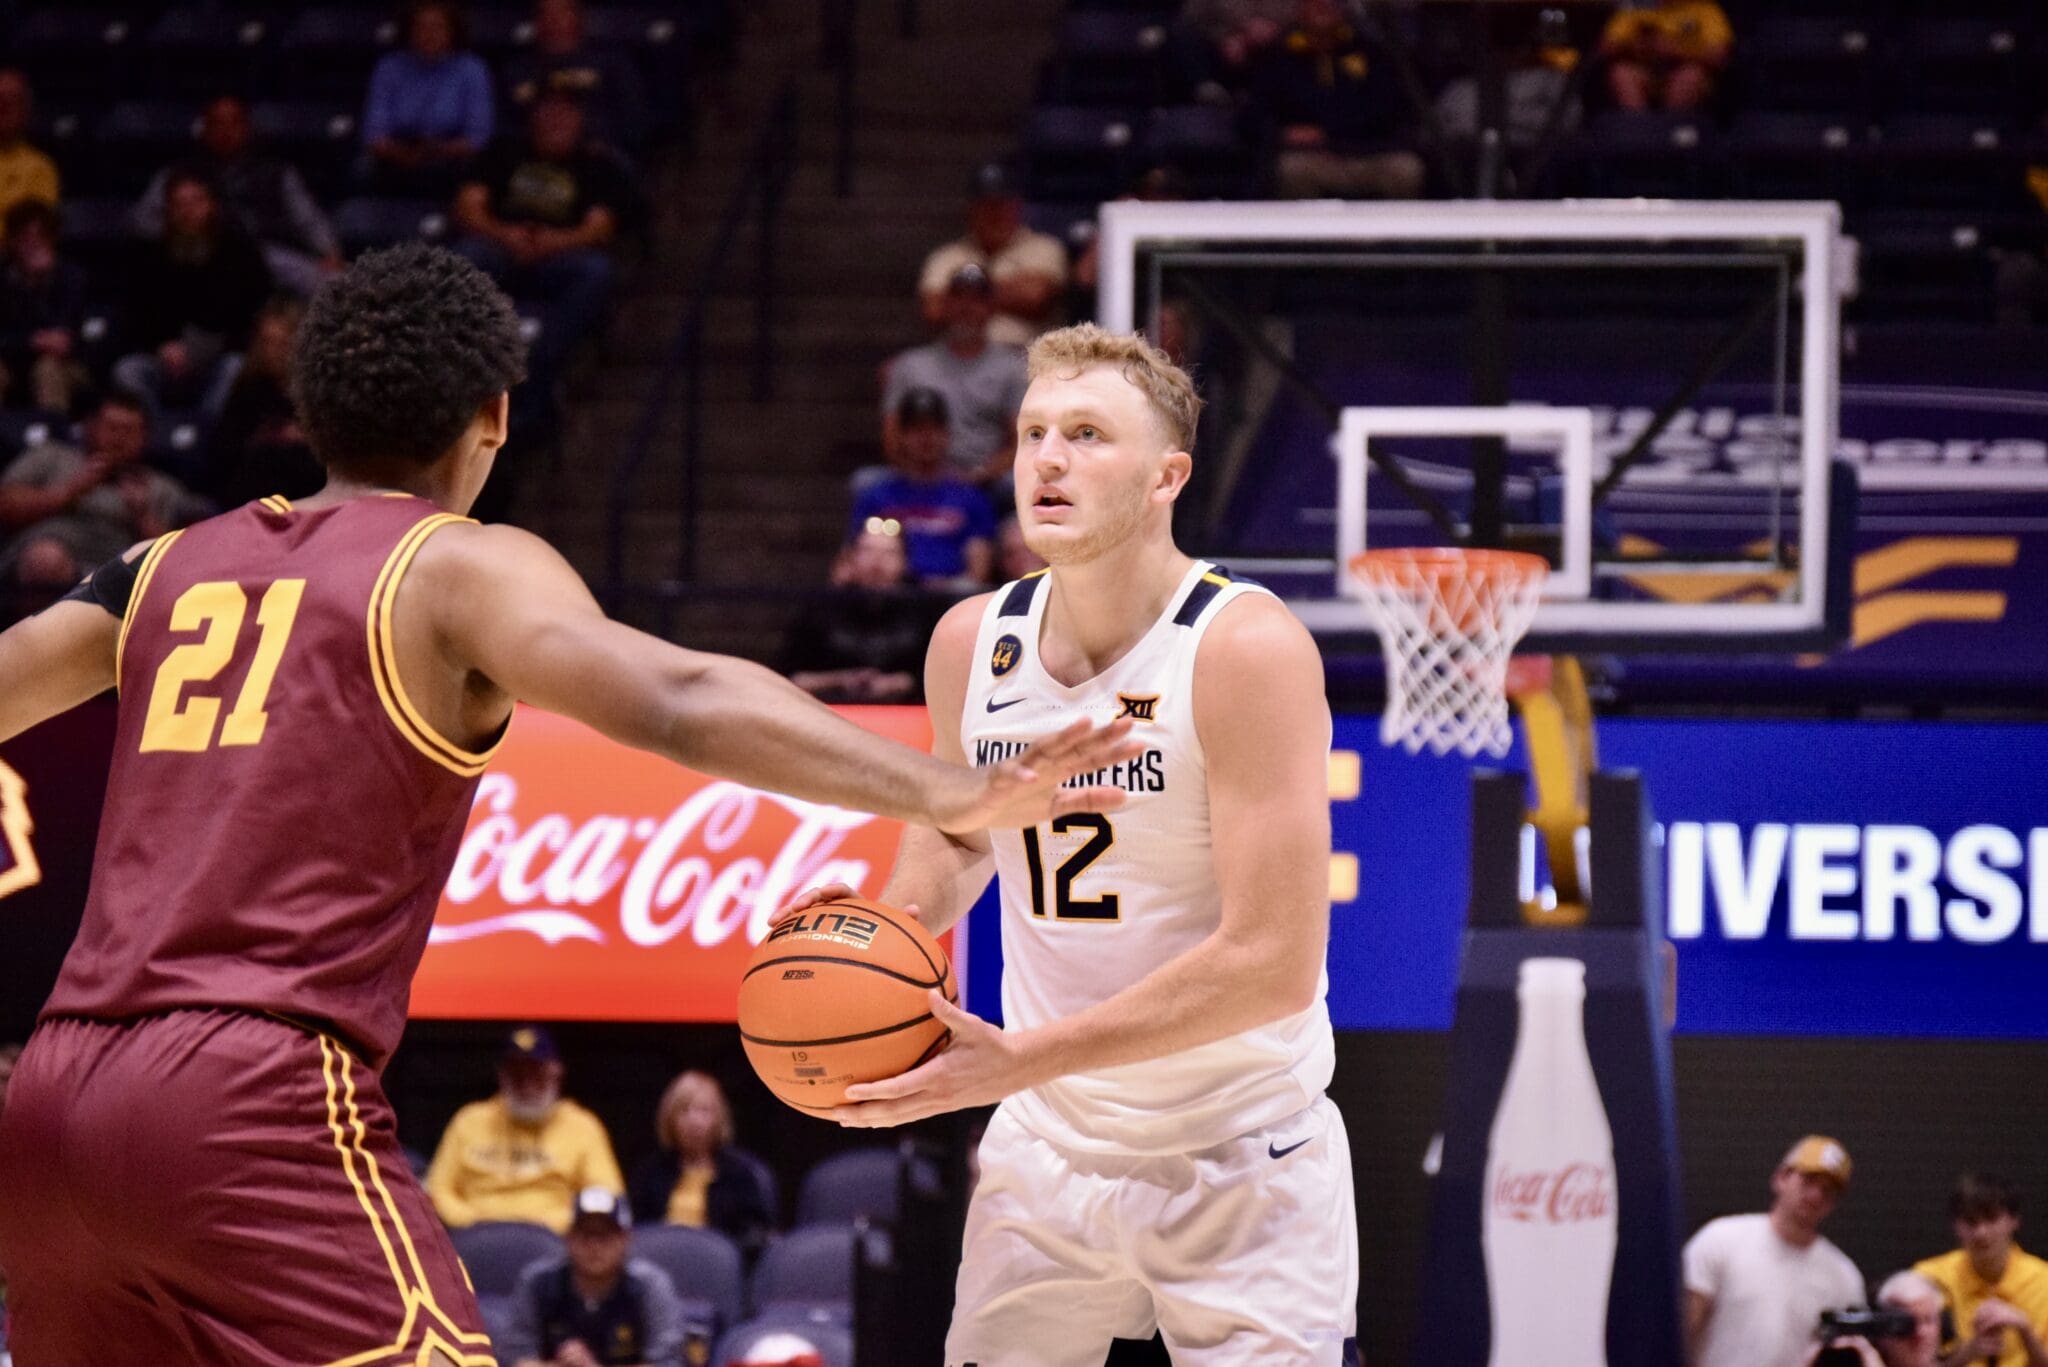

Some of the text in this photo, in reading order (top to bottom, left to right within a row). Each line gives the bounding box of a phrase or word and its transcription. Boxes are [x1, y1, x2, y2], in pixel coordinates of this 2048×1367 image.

[139, 579, 306, 753] 21
[992, 650, 1012, 669] 44
[1115, 696, 1158, 721] XII
[1022, 811, 1122, 923] 12
[1518, 821, 2048, 945] IVERSI
[767, 913, 880, 943] ELITE
